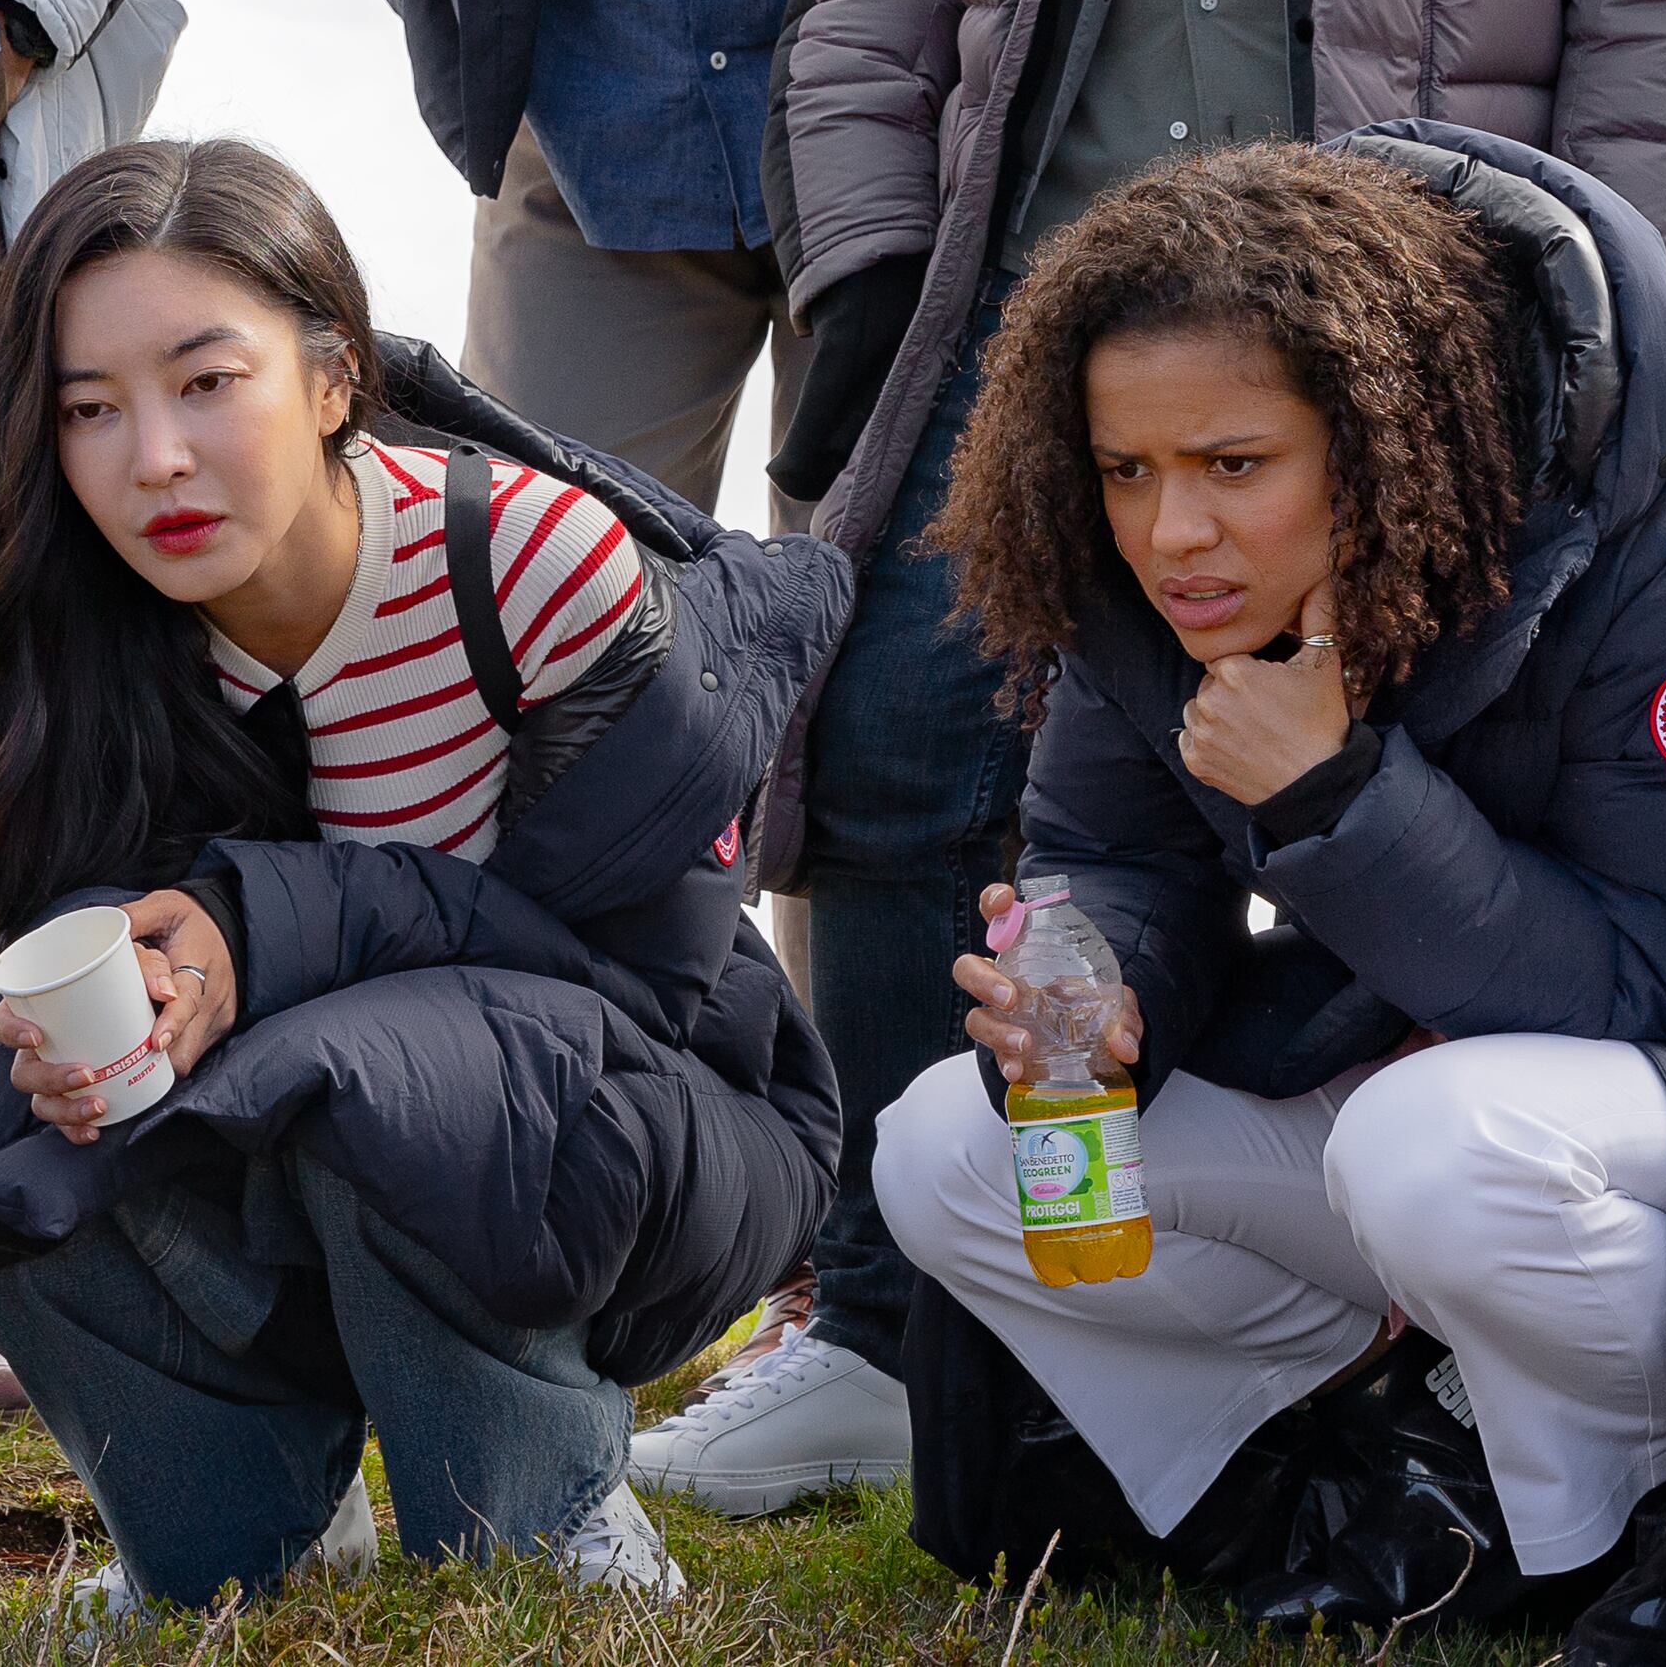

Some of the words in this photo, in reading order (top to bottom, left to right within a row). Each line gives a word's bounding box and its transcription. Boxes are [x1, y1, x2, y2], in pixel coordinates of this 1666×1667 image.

[106, 1045, 148, 1077] ARISTEA
[128, 1062, 157, 1086] ARISTEA
[1023, 1165, 1071, 1178] ECOGREEN
[1025, 1200, 1080, 1218] PROTEGGI
